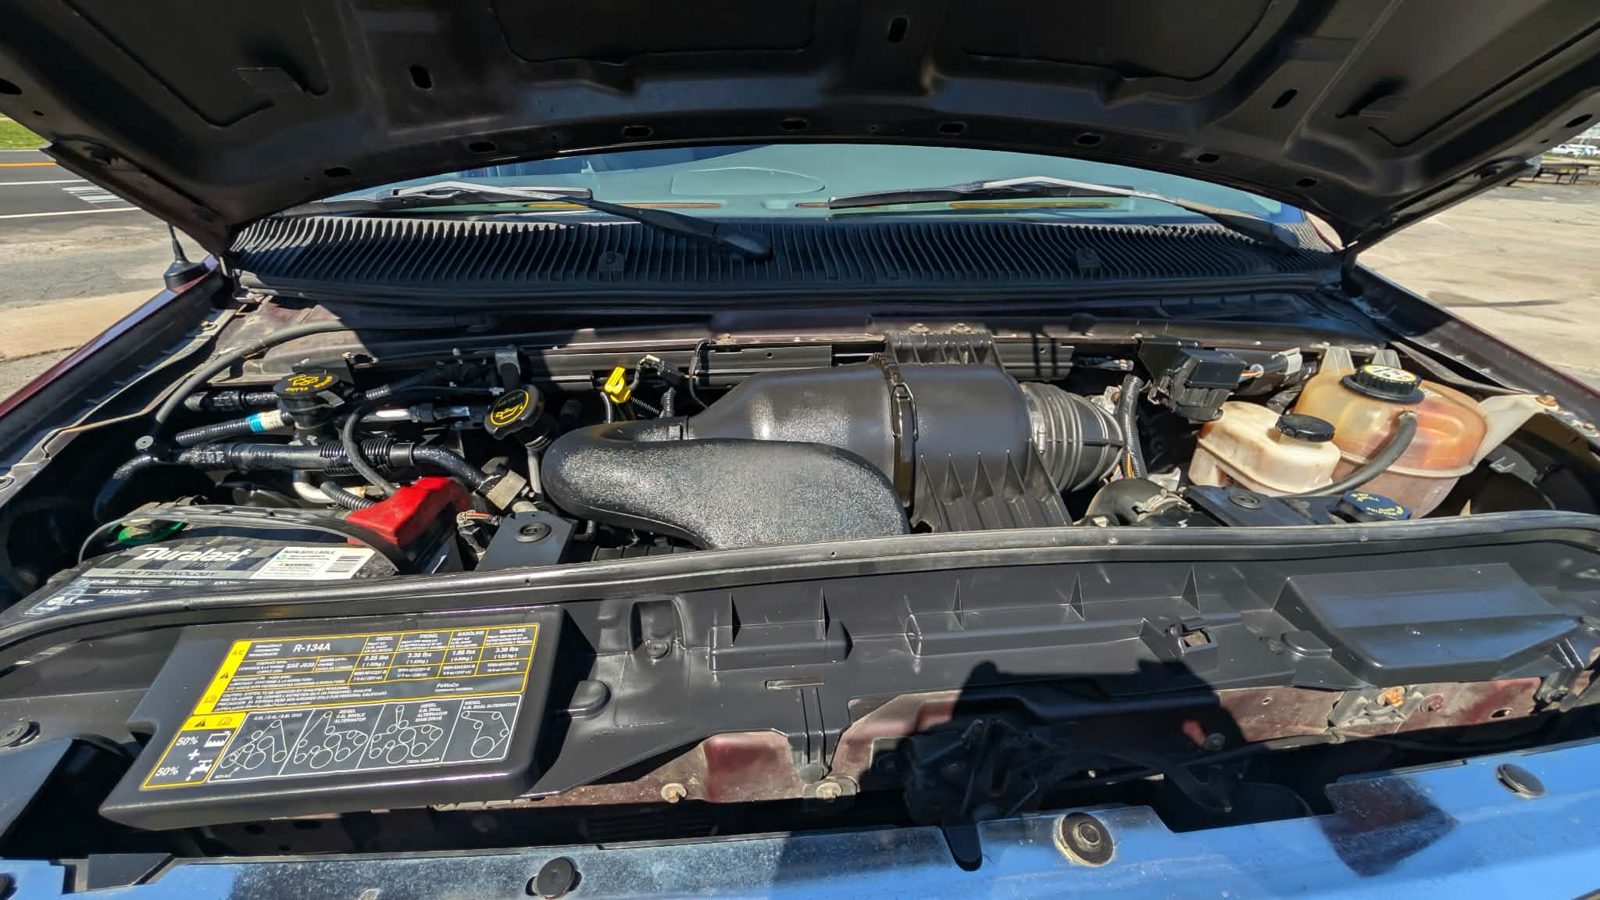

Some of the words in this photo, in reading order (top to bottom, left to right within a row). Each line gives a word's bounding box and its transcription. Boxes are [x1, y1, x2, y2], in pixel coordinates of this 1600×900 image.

[135, 547, 253, 562] Duralast
[293, 643, 332, 653] R-134A
[176, 736, 199, 746] 50%
[155, 766, 180, 777] 50%
